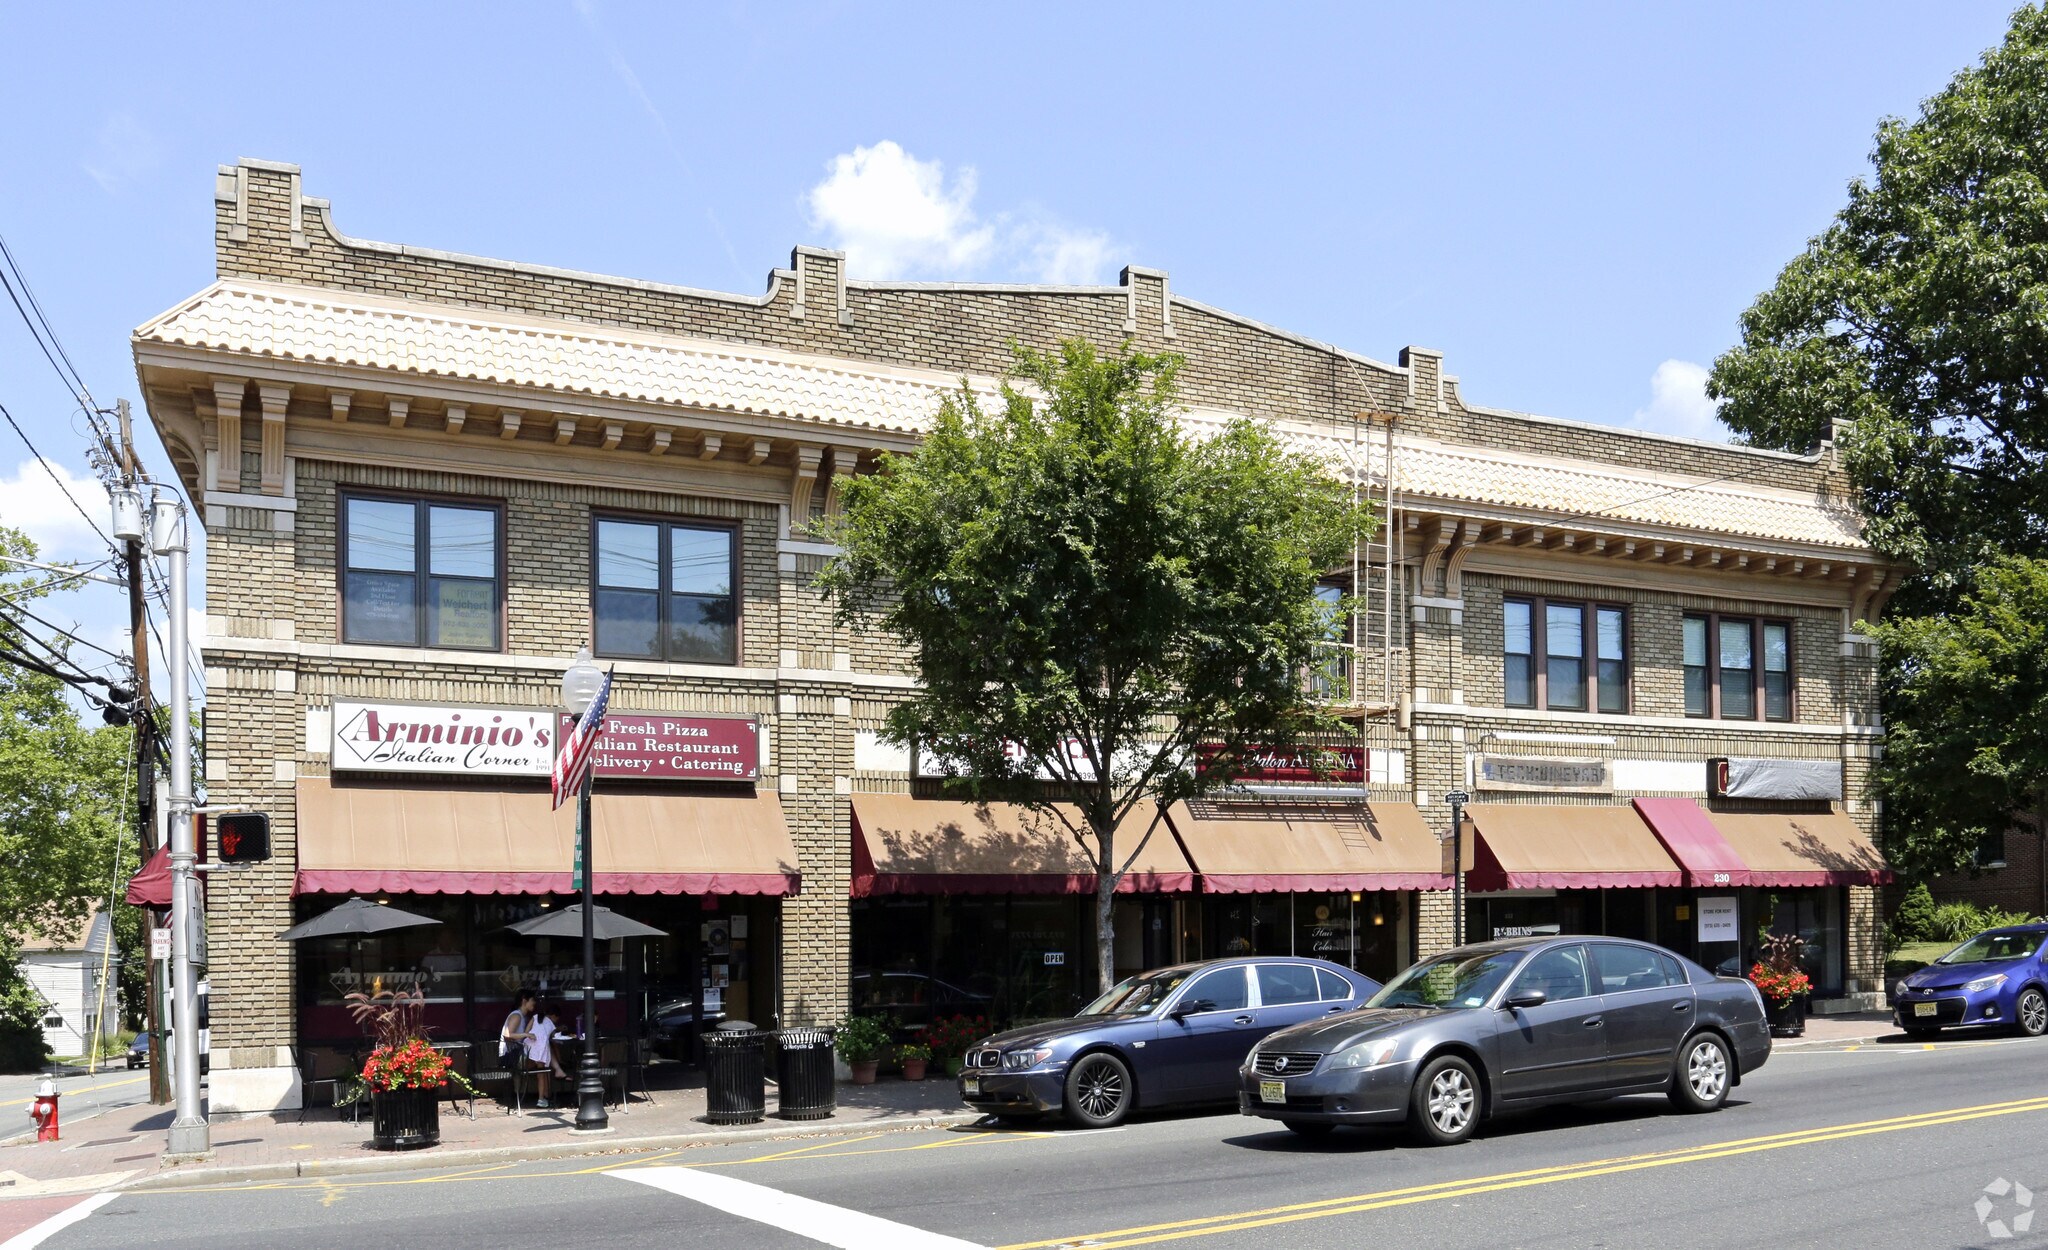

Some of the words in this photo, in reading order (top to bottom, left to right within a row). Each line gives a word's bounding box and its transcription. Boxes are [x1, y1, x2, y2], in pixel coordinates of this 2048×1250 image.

[350, 710, 551, 748] Arminio's
[608, 720, 656, 735] Fresh
[662, 723, 708, 737] Pizza
[373, 738, 458, 763] Italian
[464, 743, 531, 769] Corner
[594, 737, 637, 751] alian
[644, 739, 739, 754] Restaurant
[590, 754, 653, 772] elivery
[671, 756, 743, 774] Catering
[1714, 873, 1730, 883] 230
[1045, 954, 1064, 963] OPEN
